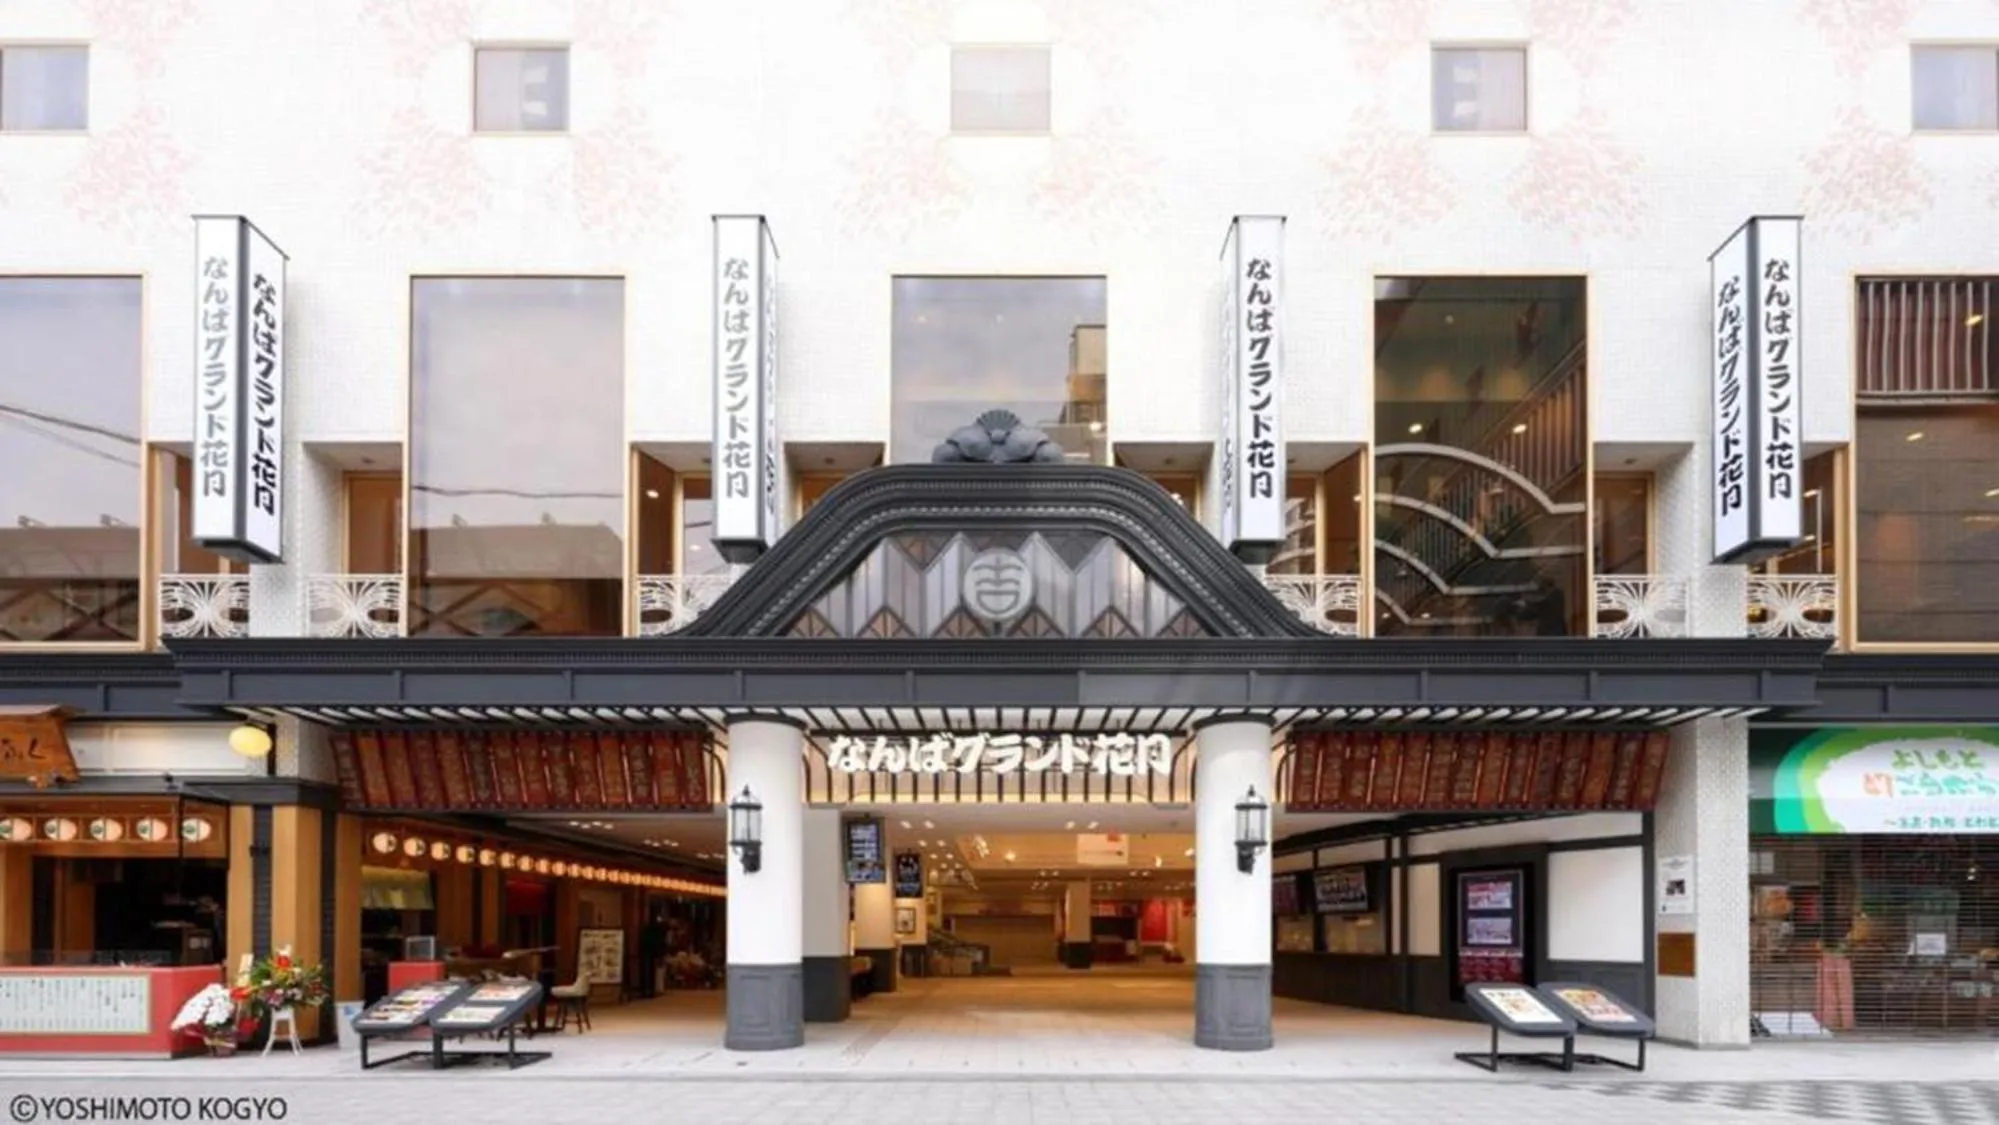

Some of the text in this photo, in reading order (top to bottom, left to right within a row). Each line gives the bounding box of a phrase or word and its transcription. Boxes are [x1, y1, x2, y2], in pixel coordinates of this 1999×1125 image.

[1246, 257, 1276, 500] なんばグランド花月
[1718, 275, 1743, 518] なんばグランド花月
[1763, 257, 1795, 500] なんばグランド花月
[827, 731, 1173, 776] なんばグランド花月
